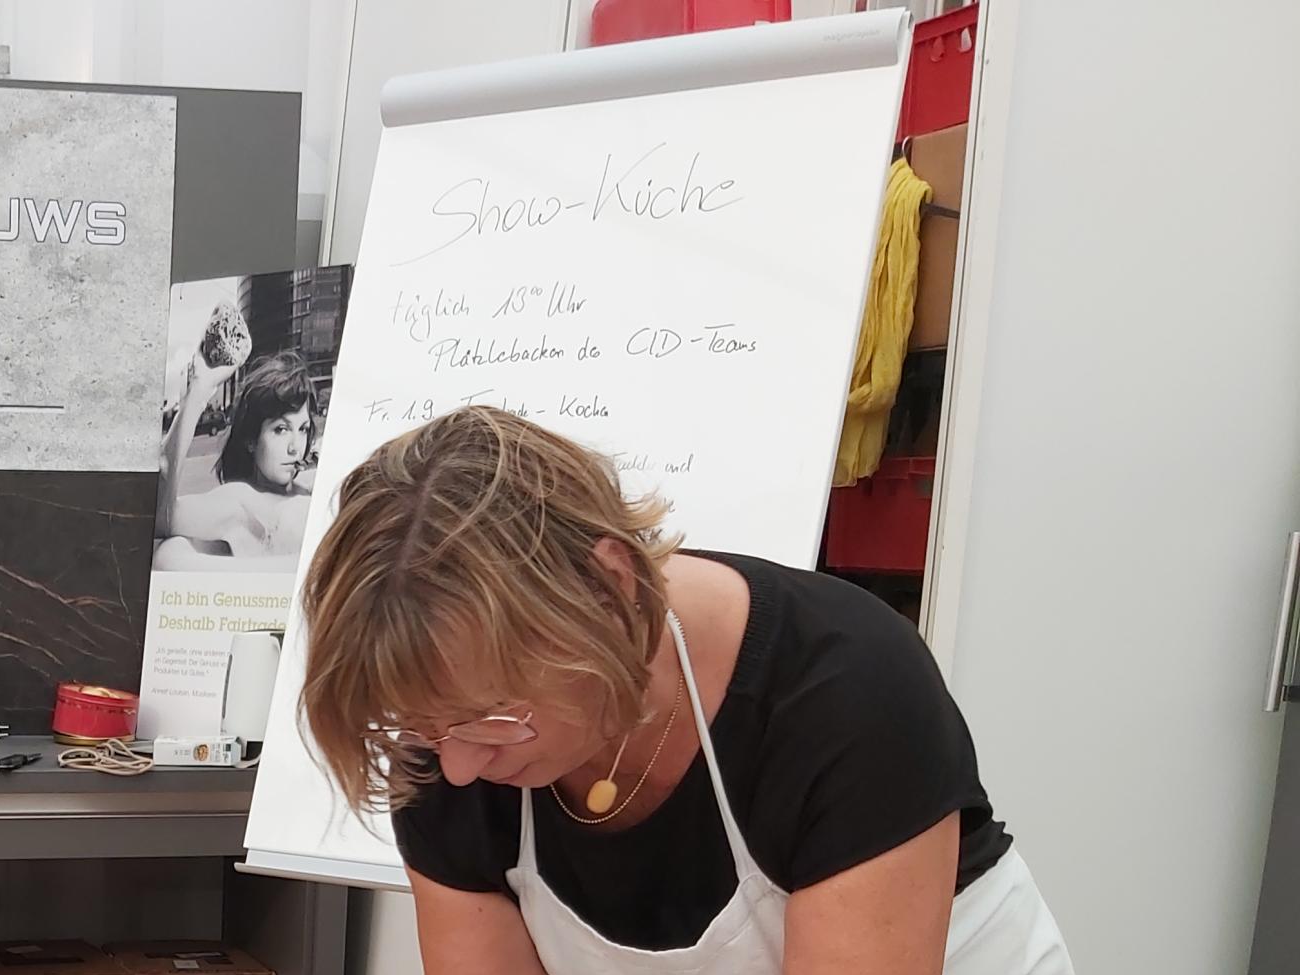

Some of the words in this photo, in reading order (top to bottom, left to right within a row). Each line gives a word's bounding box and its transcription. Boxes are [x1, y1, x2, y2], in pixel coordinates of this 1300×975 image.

[390, 288, 470, 342] täglich
[547, 281, 588, 318] Uhr
[160, 590, 183, 606] Ich
[186, 591, 209, 606] bin
[158, 614, 215, 632] Deshalb
